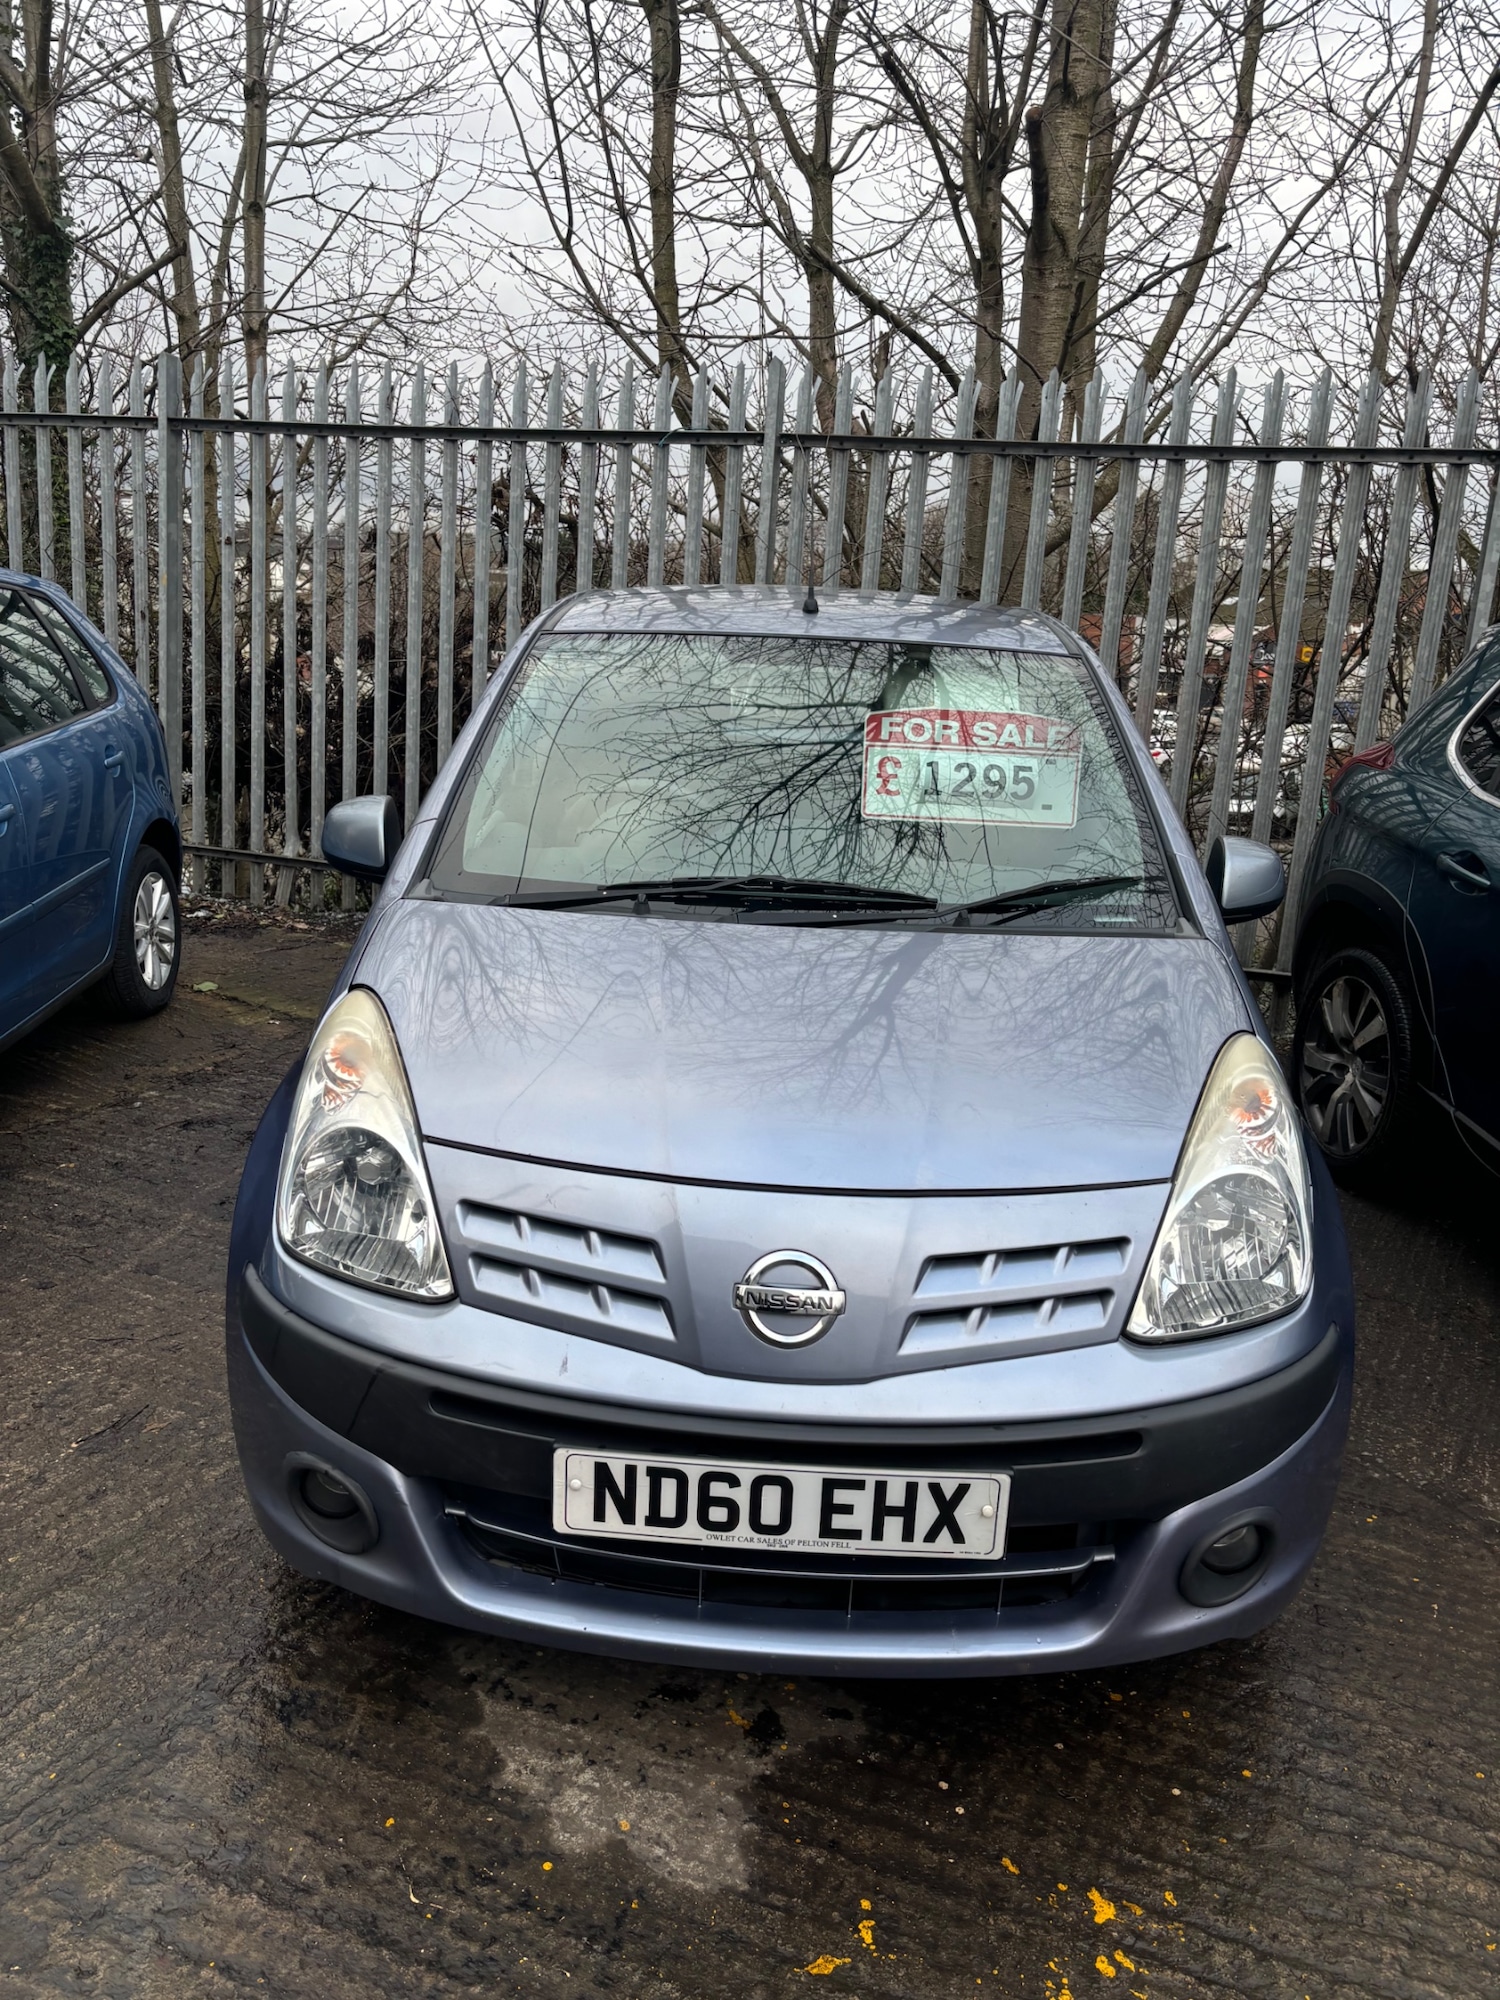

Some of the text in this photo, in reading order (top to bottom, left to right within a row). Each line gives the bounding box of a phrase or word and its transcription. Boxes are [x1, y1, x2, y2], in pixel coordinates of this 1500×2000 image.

[880, 717, 1070, 750] FOR SALE
[746, 1291, 834, 1311] NISSAN
[593, 1461, 971, 1545] ND60 EHX
[706, 1533, 736, 1543] OWLET
[737, 1535, 755, 1544] CAR
[757, 1537, 783, 1545] SALES
[785, 1538, 796, 1546] OF
[797, 1539, 830, 1548] PELTON
[831, 1541, 851, 1549] FELL
